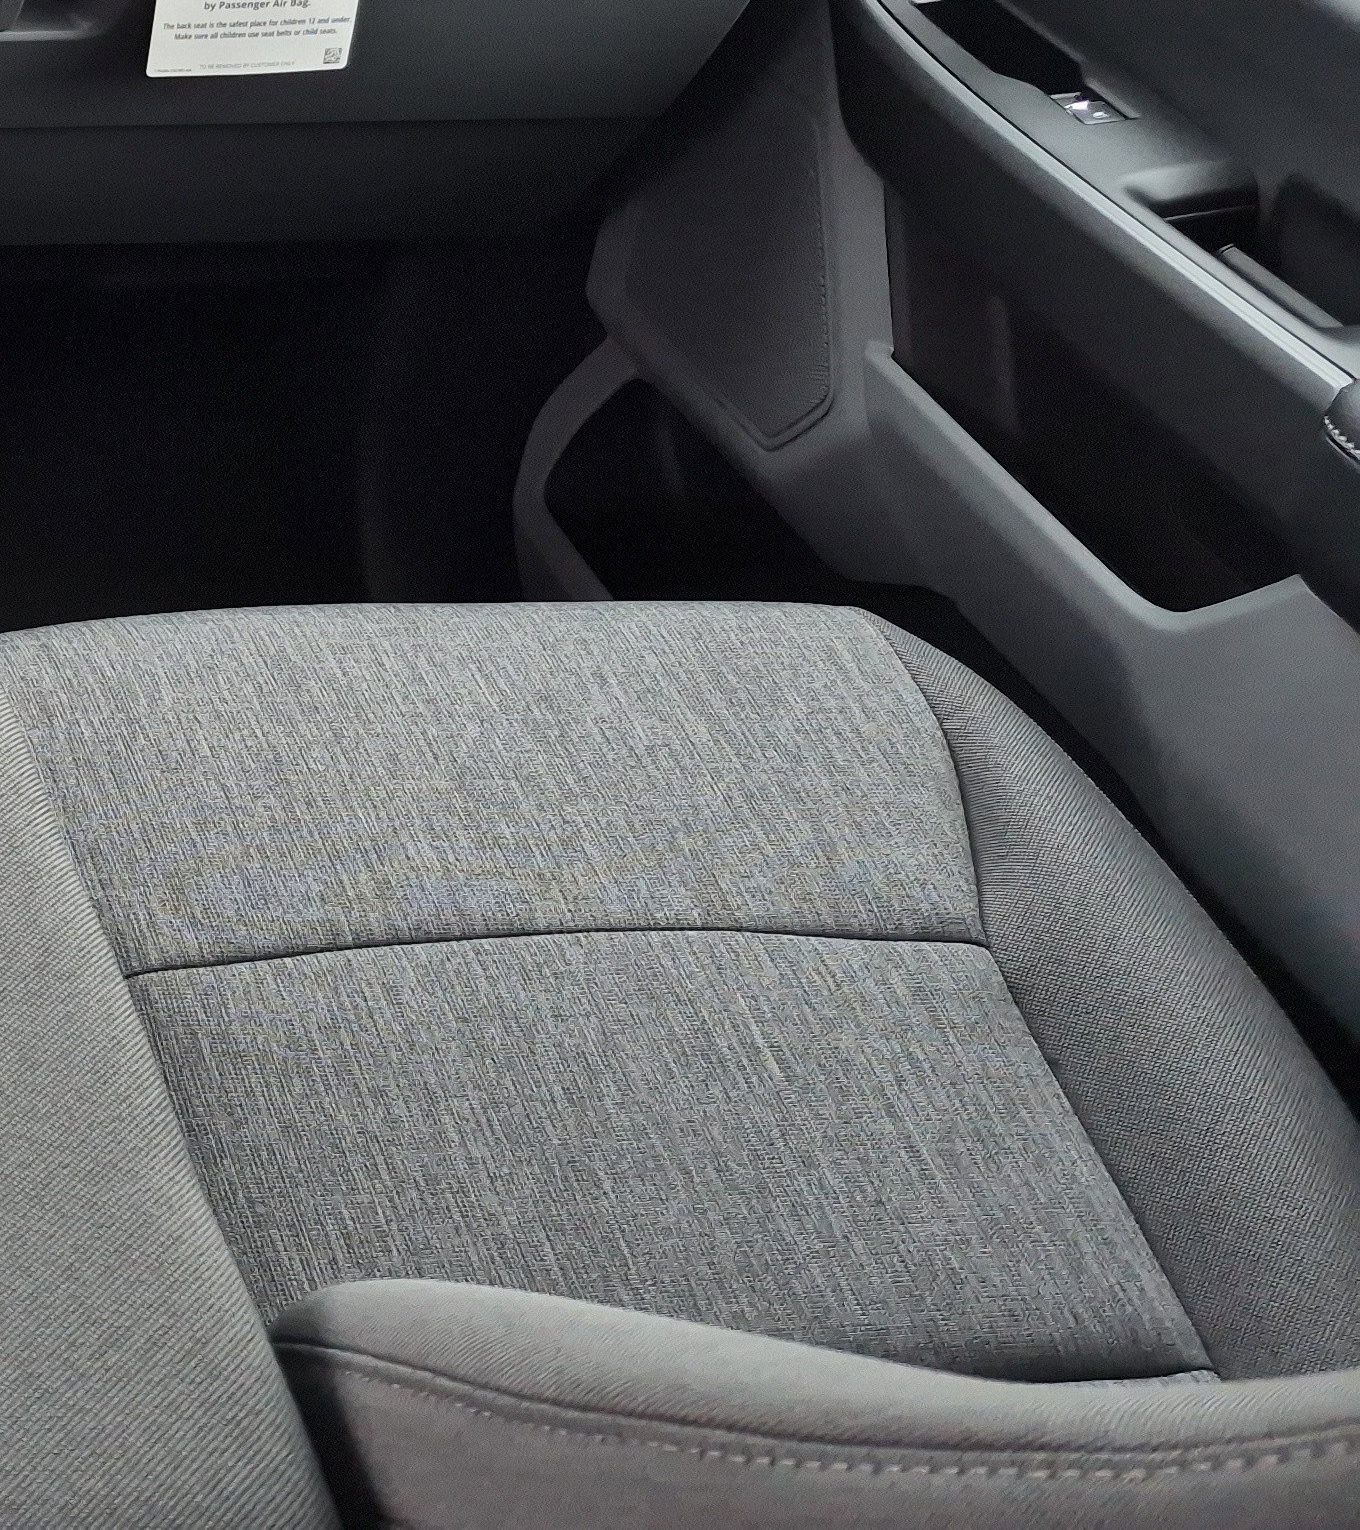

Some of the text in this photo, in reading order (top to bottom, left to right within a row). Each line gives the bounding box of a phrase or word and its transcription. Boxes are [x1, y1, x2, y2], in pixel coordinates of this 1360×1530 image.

[204, 2, 216, 11] by
[219, 1, 270, 11] Passenger
[273, 0, 287, 8] Air
